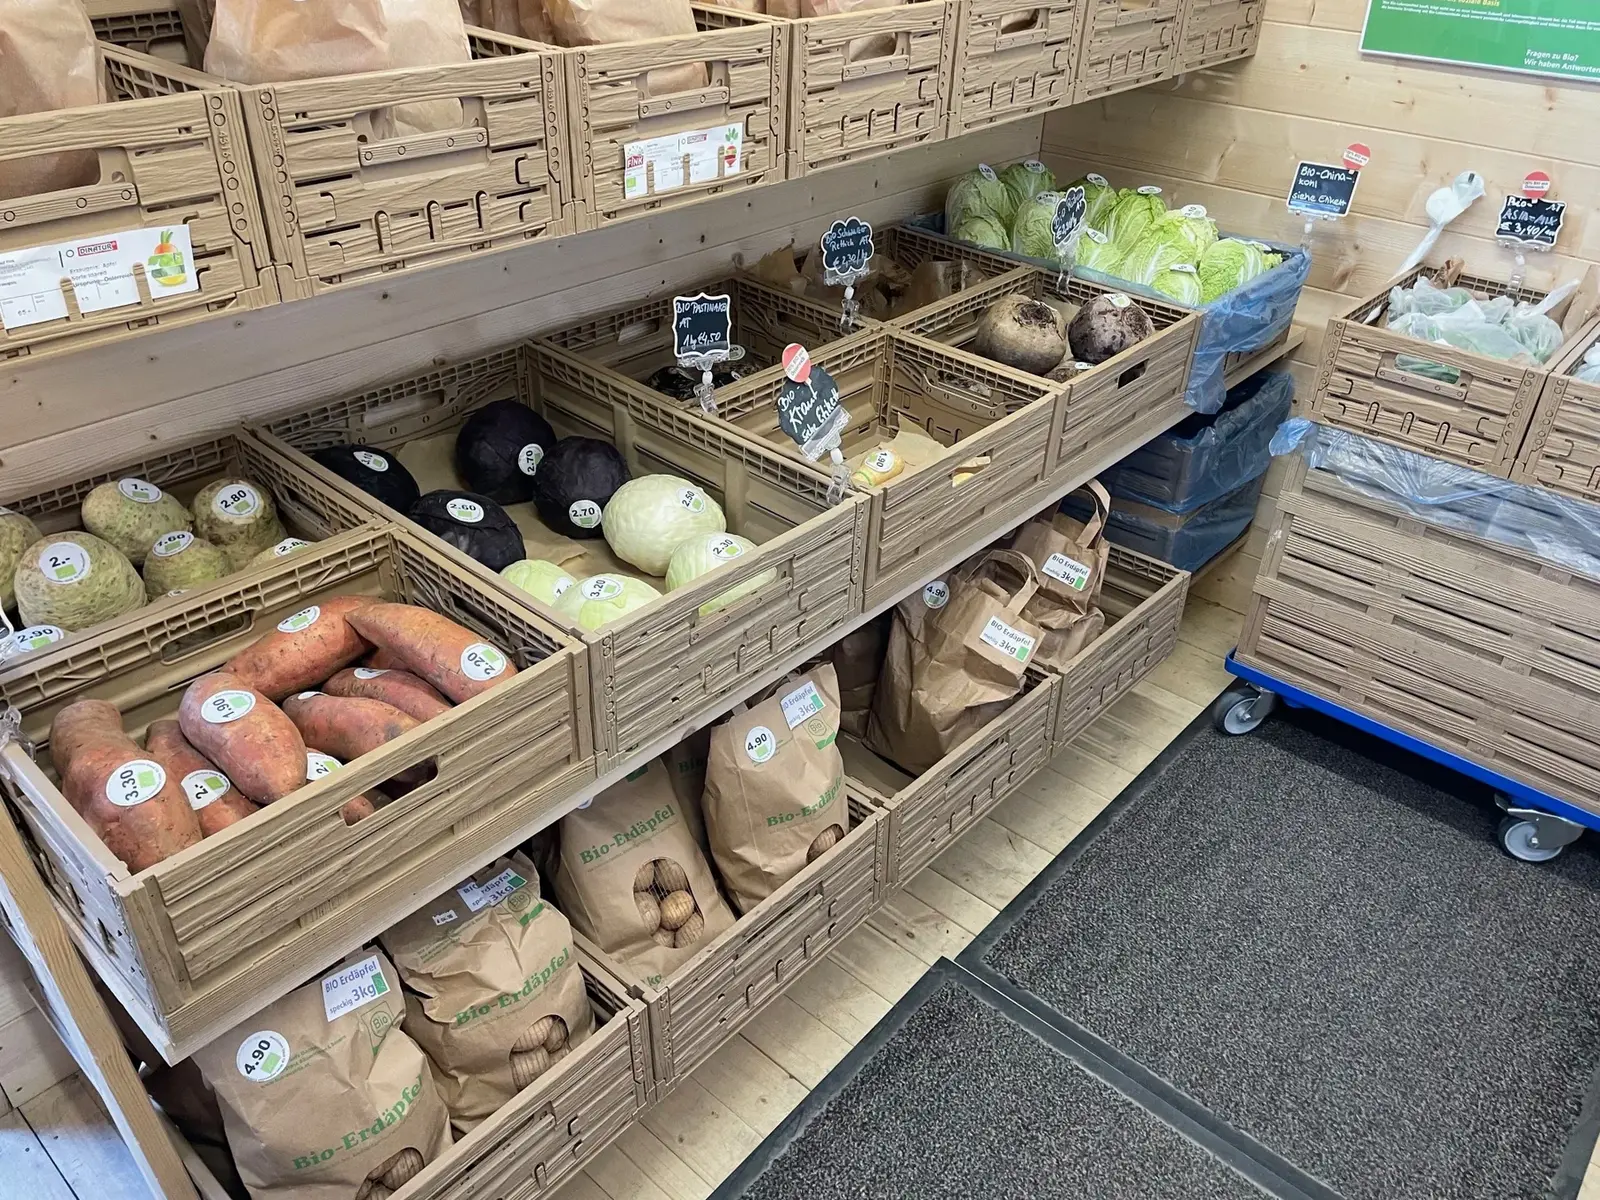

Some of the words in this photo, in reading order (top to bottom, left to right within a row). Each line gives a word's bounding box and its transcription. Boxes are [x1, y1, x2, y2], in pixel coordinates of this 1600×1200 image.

[1526, 49, 1550, 58] Fragen
[1562, 53, 1579, 62] Bio?
[1524, 58, 1537, 66] Wir
[1538, 60, 1560, 69] haben
[1561, 63, 1600, 73] Antworten
[80, 244, 113, 255] DINATUR
[676, 302, 690, 314] BIO
[679, 317, 692, 329] AT
[788, 388, 818, 434] Kraut
[525, 450, 535, 472] 2.70
[876, 451, 888, 468] 1.90
[220, 490, 246, 508] 2.80
[450, 503, 477, 511] 2.60
[682, 490, 695, 507] 2.50
[571, 507, 595, 517] 2.70
[712, 539, 734, 554] 2.30
[49, 556, 71, 568] 2.-
[1051, 555, 1064, 565] BIO
[1064, 561, 1088, 576] Erdäpfel
[1060, 571, 1076, 585] 3kg
[590, 579, 606, 597] 3.20
[926, 585, 946, 598] 4.90
[17, 628, 53, 643] 2.90
[990, 619, 1003, 631] BIO
[1003, 628, 1031, 646] Erdäpfel
[999, 639, 1017, 655] 3kg
[467, 651, 496, 675] 2.20
[212, 698, 235, 718] 1.90
[798, 702, 816, 717] 3kg
[747, 733, 768, 751] 4.90
[120, 769, 139, 801] 3.30
[766, 776, 841, 827] Bio-Erdäpf
[579, 804, 676, 864] Bio-Erdäpfel
[481, 872, 512, 894] rdäpfel
[490, 885, 514, 902] 3kg
[325, 979, 339, 993] BIO
[339, 961, 377, 985] Erdäpfel
[455, 947, 570, 1026] Bio-Erdäpfel
[329, 998, 354, 1014] speckig
[351, 984, 377, 1002] 3kg
[372, 1015, 389, 1030] Bio
[244, 1040, 271, 1075] 4.90
[292, 1074, 423, 1170] Bio-Erdäpfel
